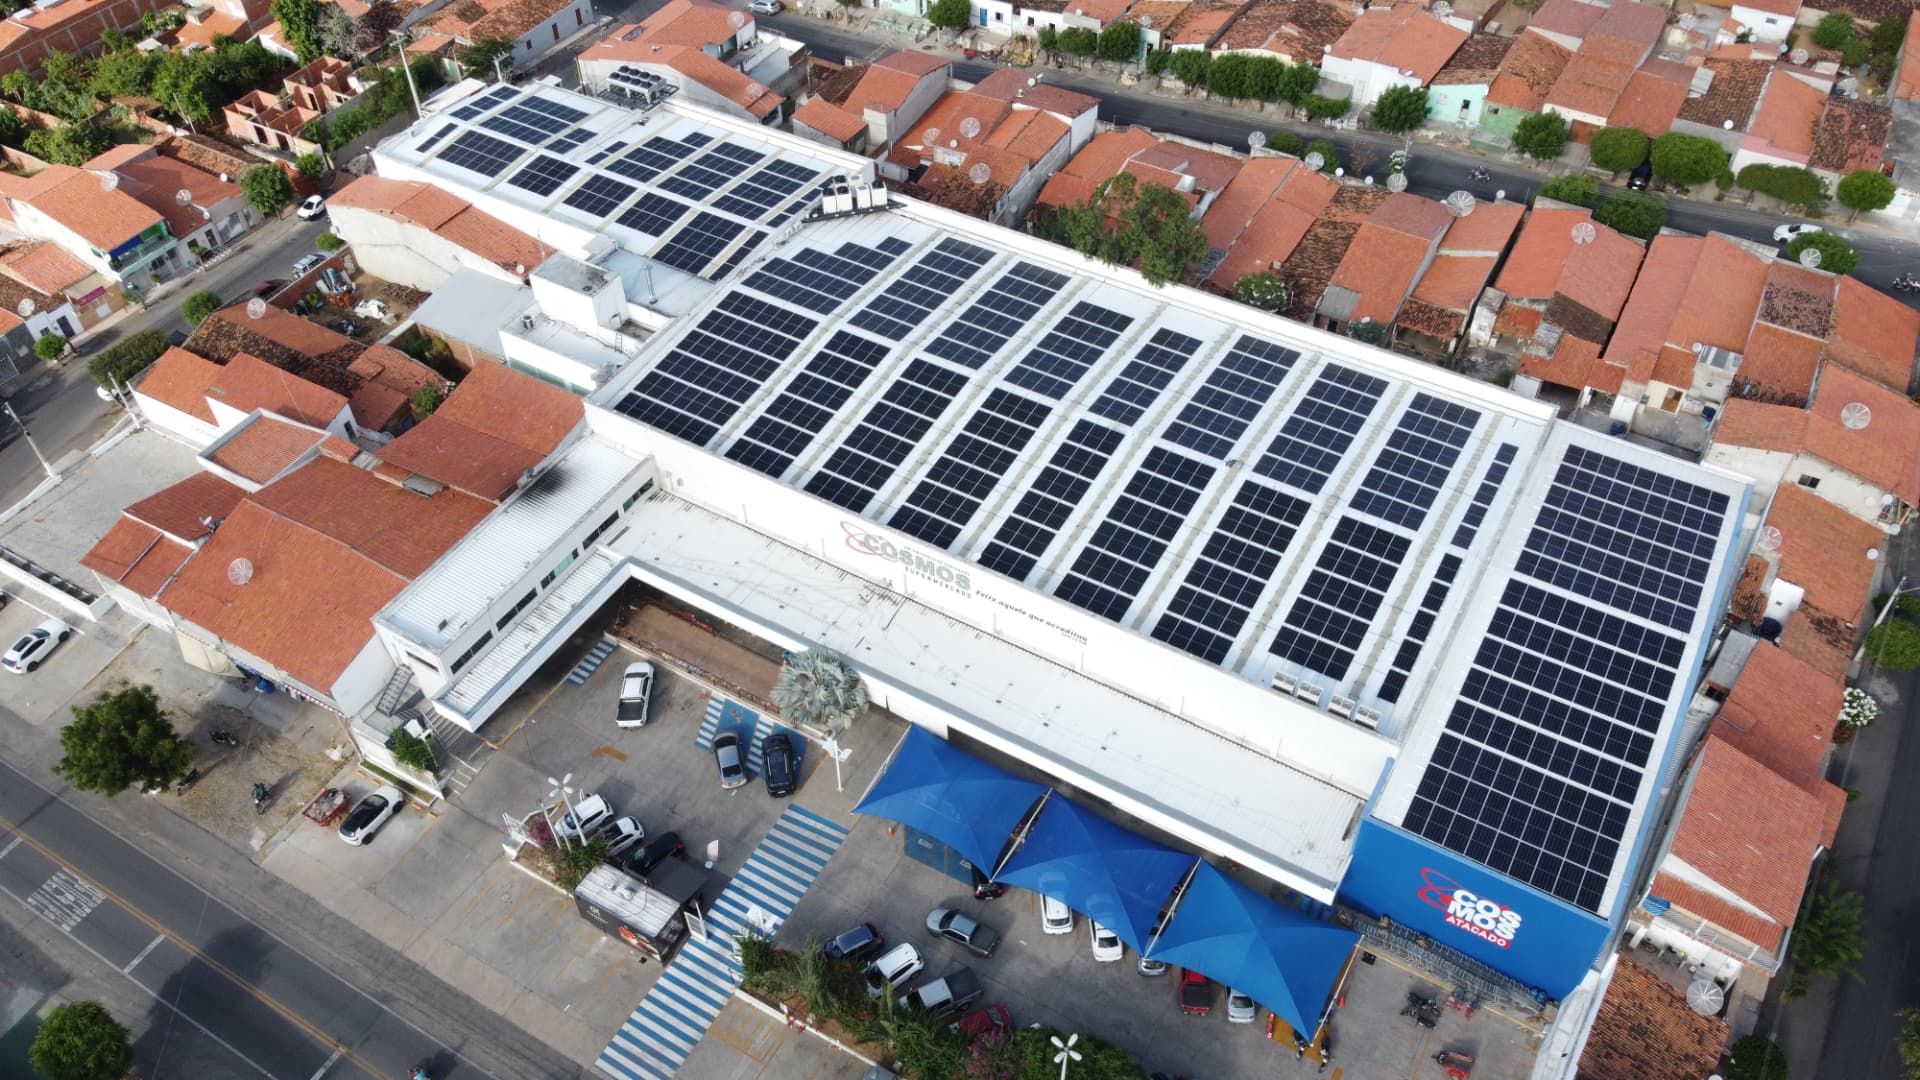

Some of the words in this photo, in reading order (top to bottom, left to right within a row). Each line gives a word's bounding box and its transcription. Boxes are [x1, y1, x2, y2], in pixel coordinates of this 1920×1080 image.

[864, 533, 971, 590] COSMOS
[1447, 899, 1516, 940] MOS
[1452, 889, 1522, 929] COS
[1446, 915, 1508, 947] ATACADO
